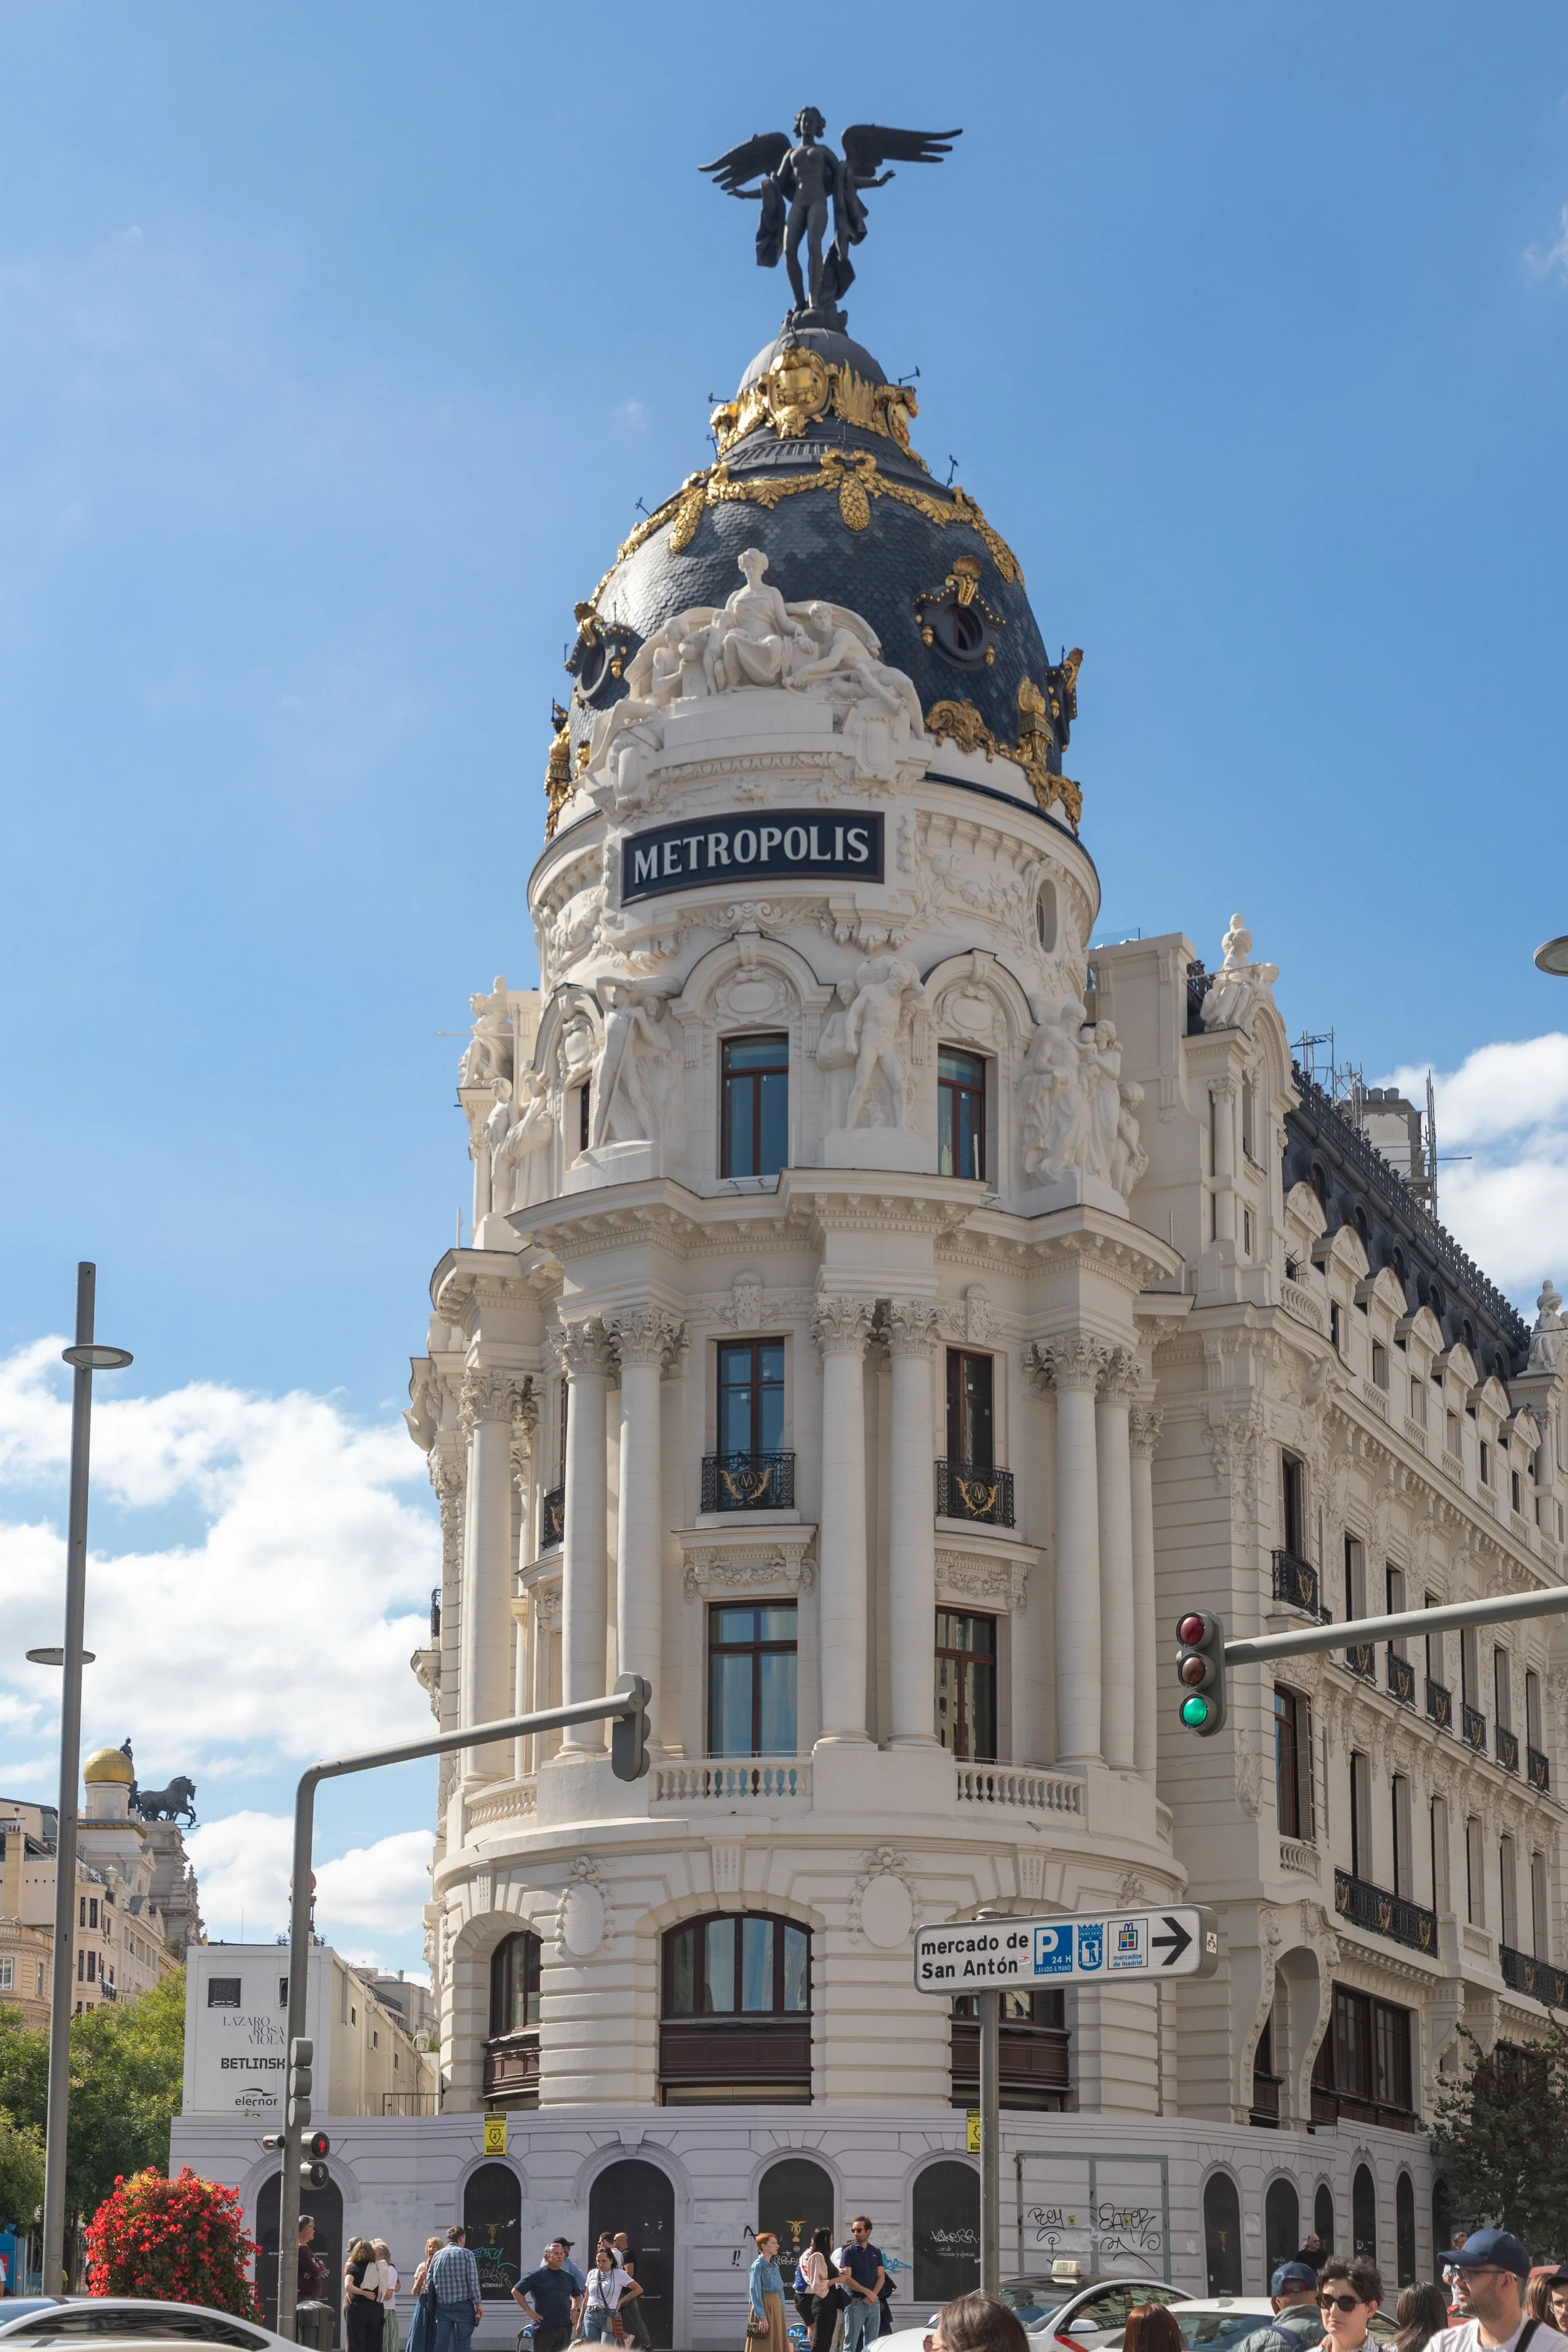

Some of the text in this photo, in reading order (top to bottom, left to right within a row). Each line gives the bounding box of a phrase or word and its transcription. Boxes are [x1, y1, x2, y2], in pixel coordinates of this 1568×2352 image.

[633, 825, 869, 884] METROPOLIS
[921, 1932, 1029, 1956] mercado de
[1036, 1929, 1059, 1965] P
[921, 1963, 955, 1979] San
[963, 1957, 1017, 1976] Antón
[221, 2058, 285, 2069] BETLINSK
[235, 2096, 278, 2107] elecnor
